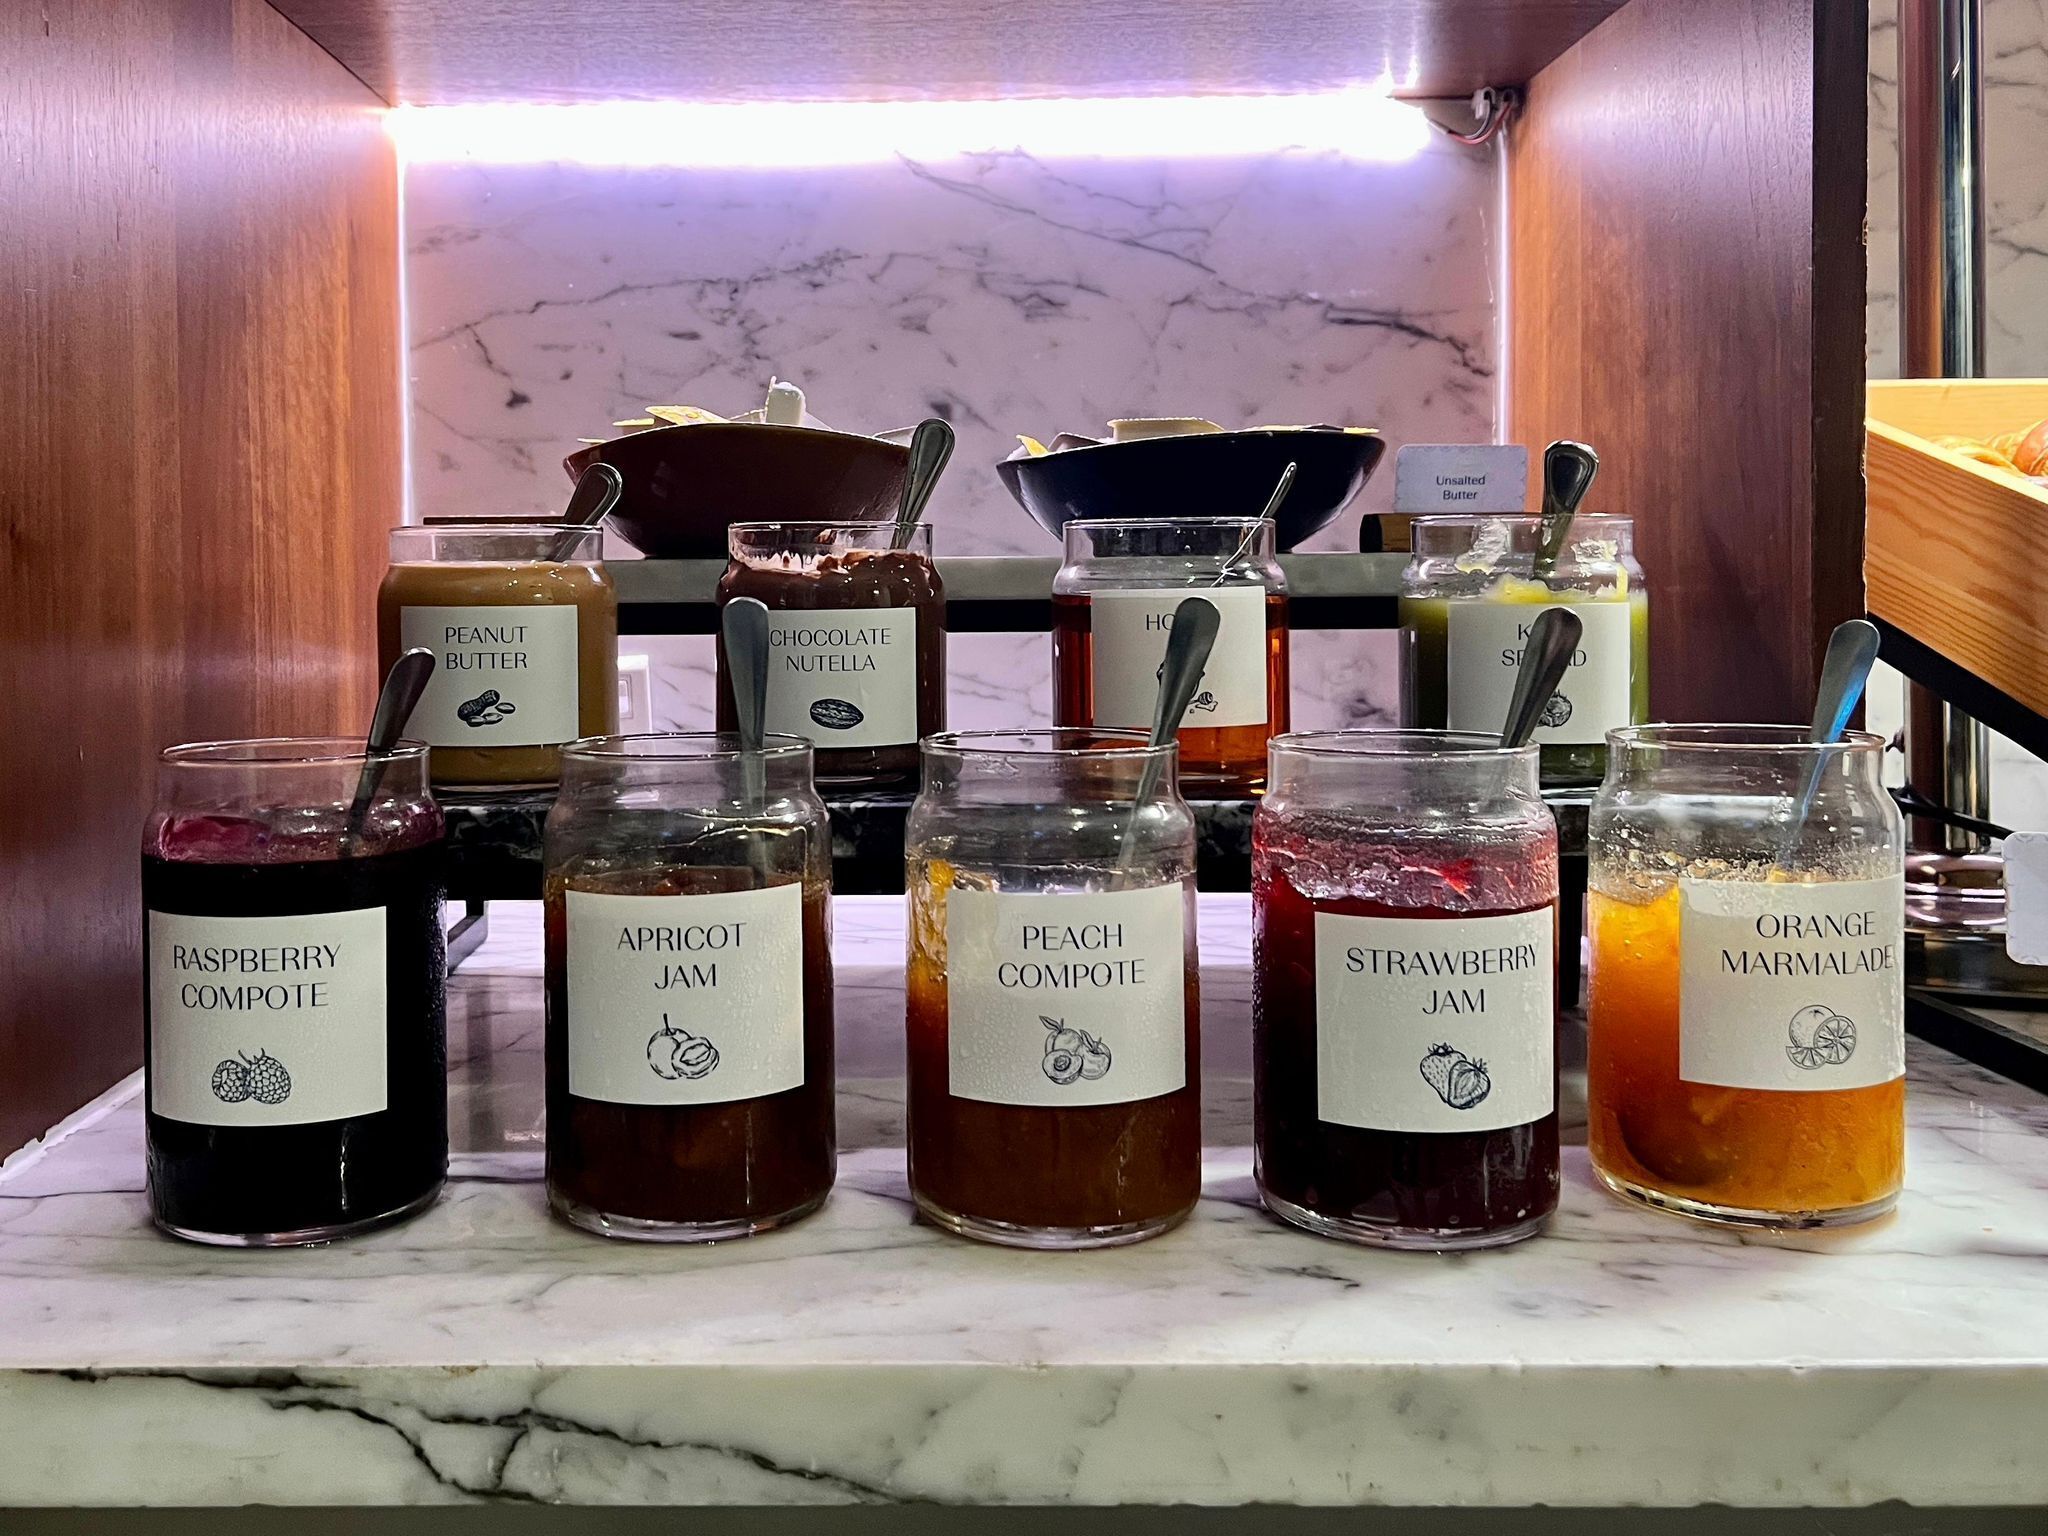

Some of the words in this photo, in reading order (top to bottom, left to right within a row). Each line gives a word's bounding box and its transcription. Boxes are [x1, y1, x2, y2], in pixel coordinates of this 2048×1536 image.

[1436, 475, 1486, 486] Unsalted
[1443, 490, 1478, 500] Butter
[445, 626, 528, 644] PEANUT
[770, 628, 892, 647] CHOCOLATE
[446, 652, 528, 670] BUTTER
[786, 654, 876, 673] NUTELLA
[617, 922, 747, 952] APRICOT
[1023, 923, 1122, 951] PEACH
[1756, 911, 1876, 939] ORANGE
[173, 943, 342, 973] RASPBERRY
[1346, 943, 1538, 976] STRAWBERRY
[1721, 944, 1895, 976] MARMALADE
[654, 963, 717, 990] JAM
[998, 958, 1146, 989] COMPOTE
[181, 981, 329, 1011] COMPOTE
[1422, 988, 1485, 1015] JAM
